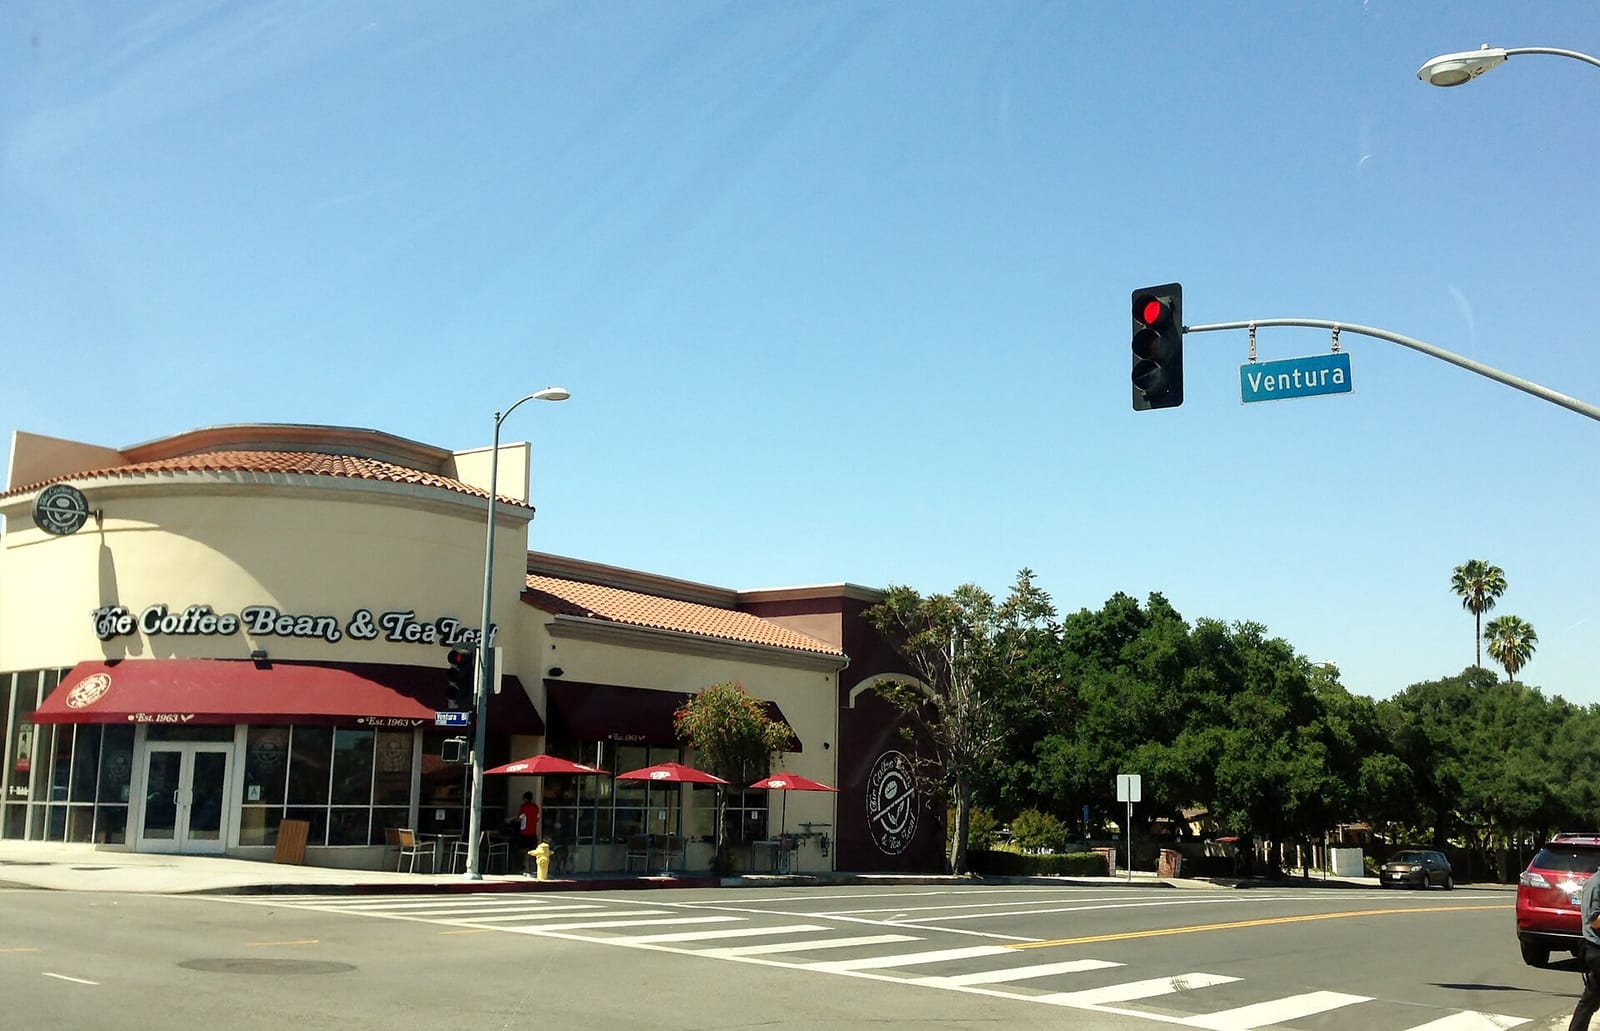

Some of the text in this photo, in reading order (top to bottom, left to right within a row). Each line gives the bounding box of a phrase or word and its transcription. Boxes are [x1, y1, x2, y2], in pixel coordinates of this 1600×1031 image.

[1247, 367, 1345, 393] Ventura
[92, 606, 134, 640] The
[139, 605, 238, 635] Coffee
[241, 606, 341, 642] Bean
[347, 610, 378, 639] &
[381, 611, 437, 643] Tea
[135, 712, 178, 723] Est. 1963
[366, 717, 409, 727] Est. 1963
[436, 712, 457, 721] Ventura
